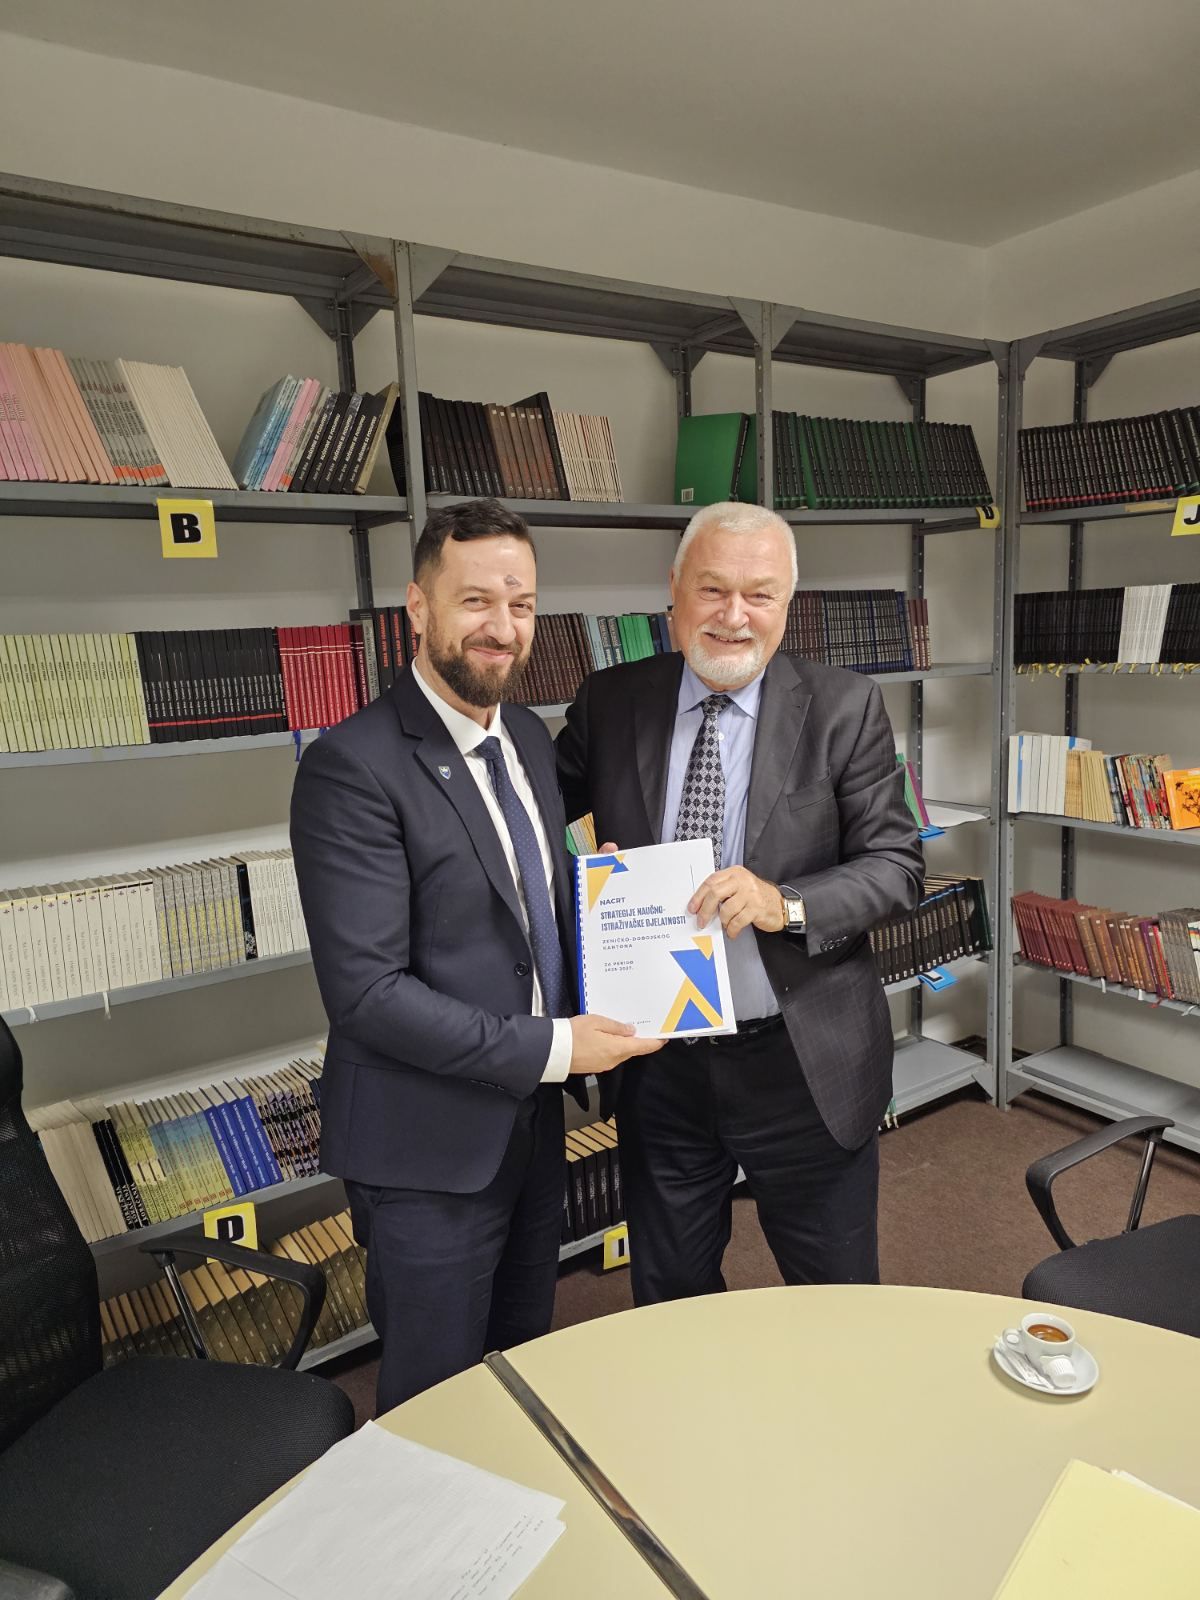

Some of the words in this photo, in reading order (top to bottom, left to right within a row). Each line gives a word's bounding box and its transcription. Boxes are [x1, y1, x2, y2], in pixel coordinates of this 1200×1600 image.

[170, 513, 202, 544] B
[600, 897, 626, 906] NACRT
[600, 908, 636, 920] STRATEGIJE
[601, 917, 645, 931] ISTRAŽIVAČKE
[645, 915, 686, 927] DJELATNOSTI
[216, 1214, 245, 1242] D
